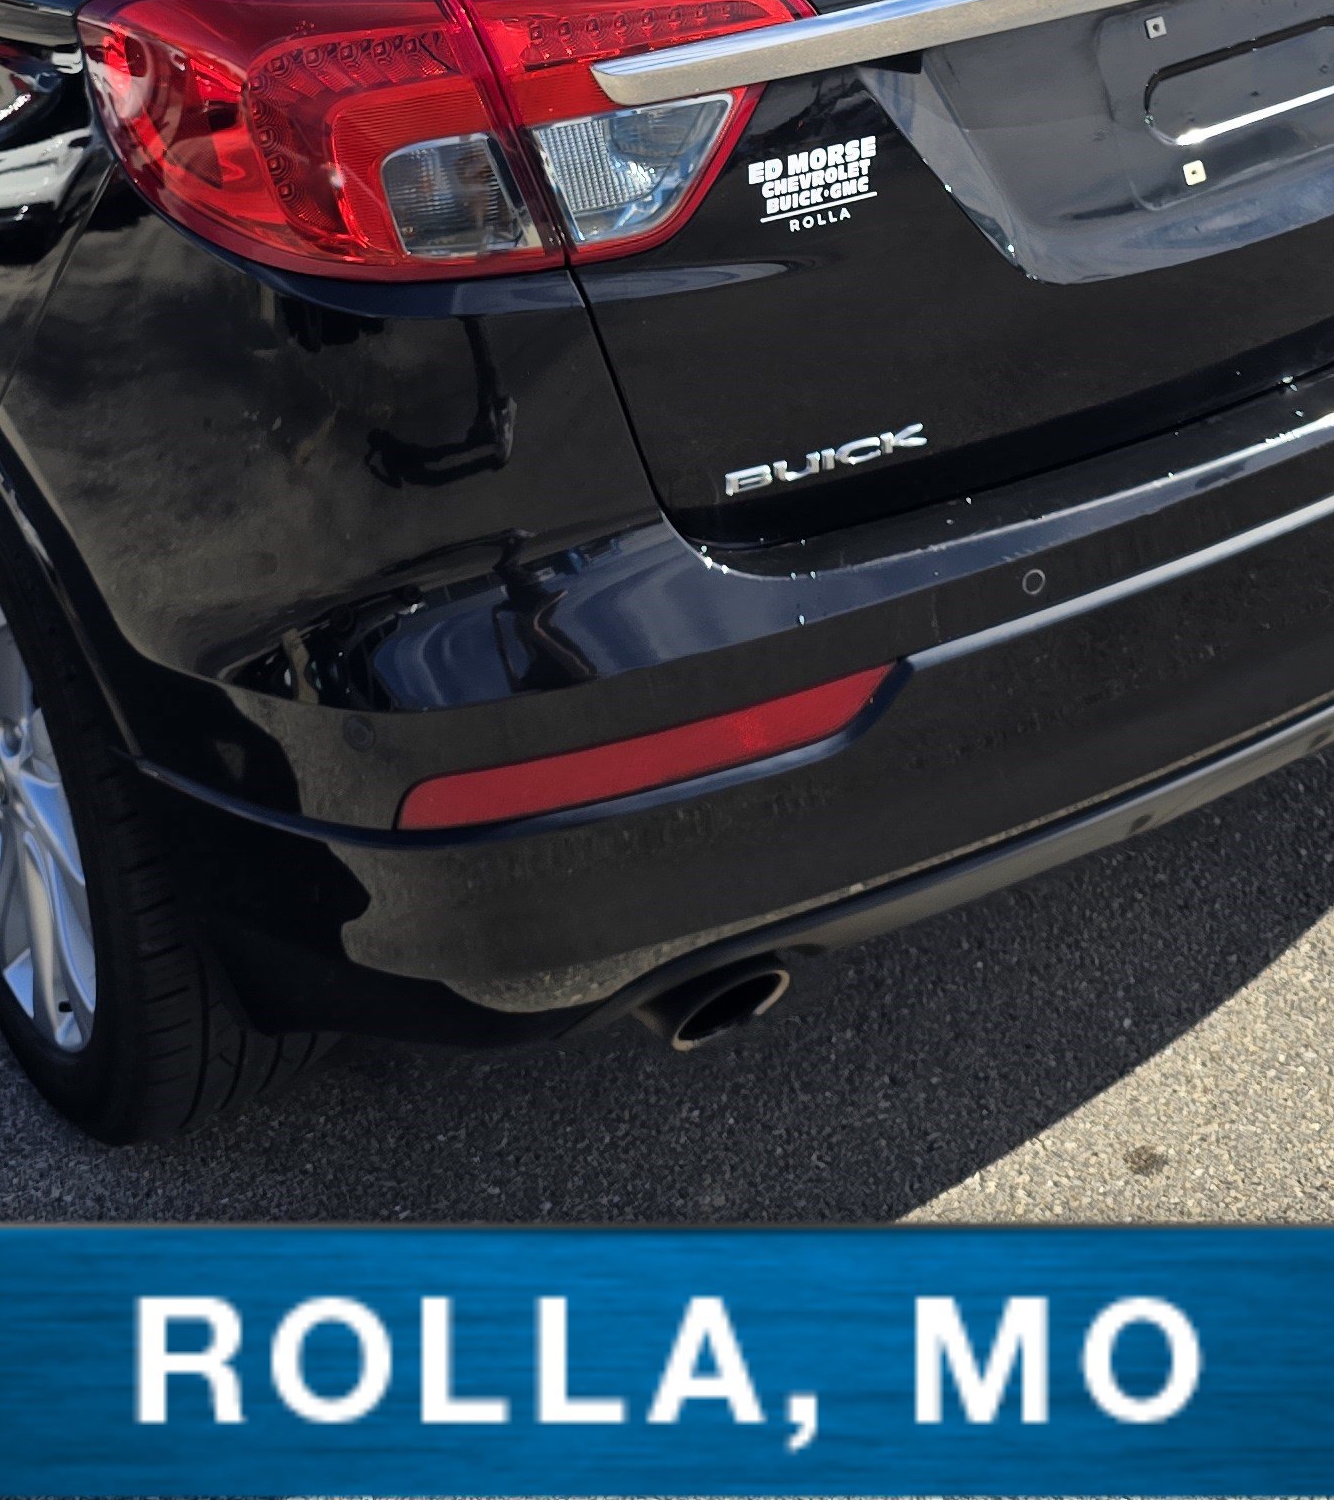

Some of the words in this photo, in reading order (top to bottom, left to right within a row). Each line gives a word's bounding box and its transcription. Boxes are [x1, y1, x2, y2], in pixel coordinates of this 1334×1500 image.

[747, 157, 784, 185] ED
[787, 134, 877, 177] MORSE
[760, 158, 871, 199] CHEVROLET
[788, 206, 852, 233] ROLLA
[724, 421, 929, 497] BUICK
